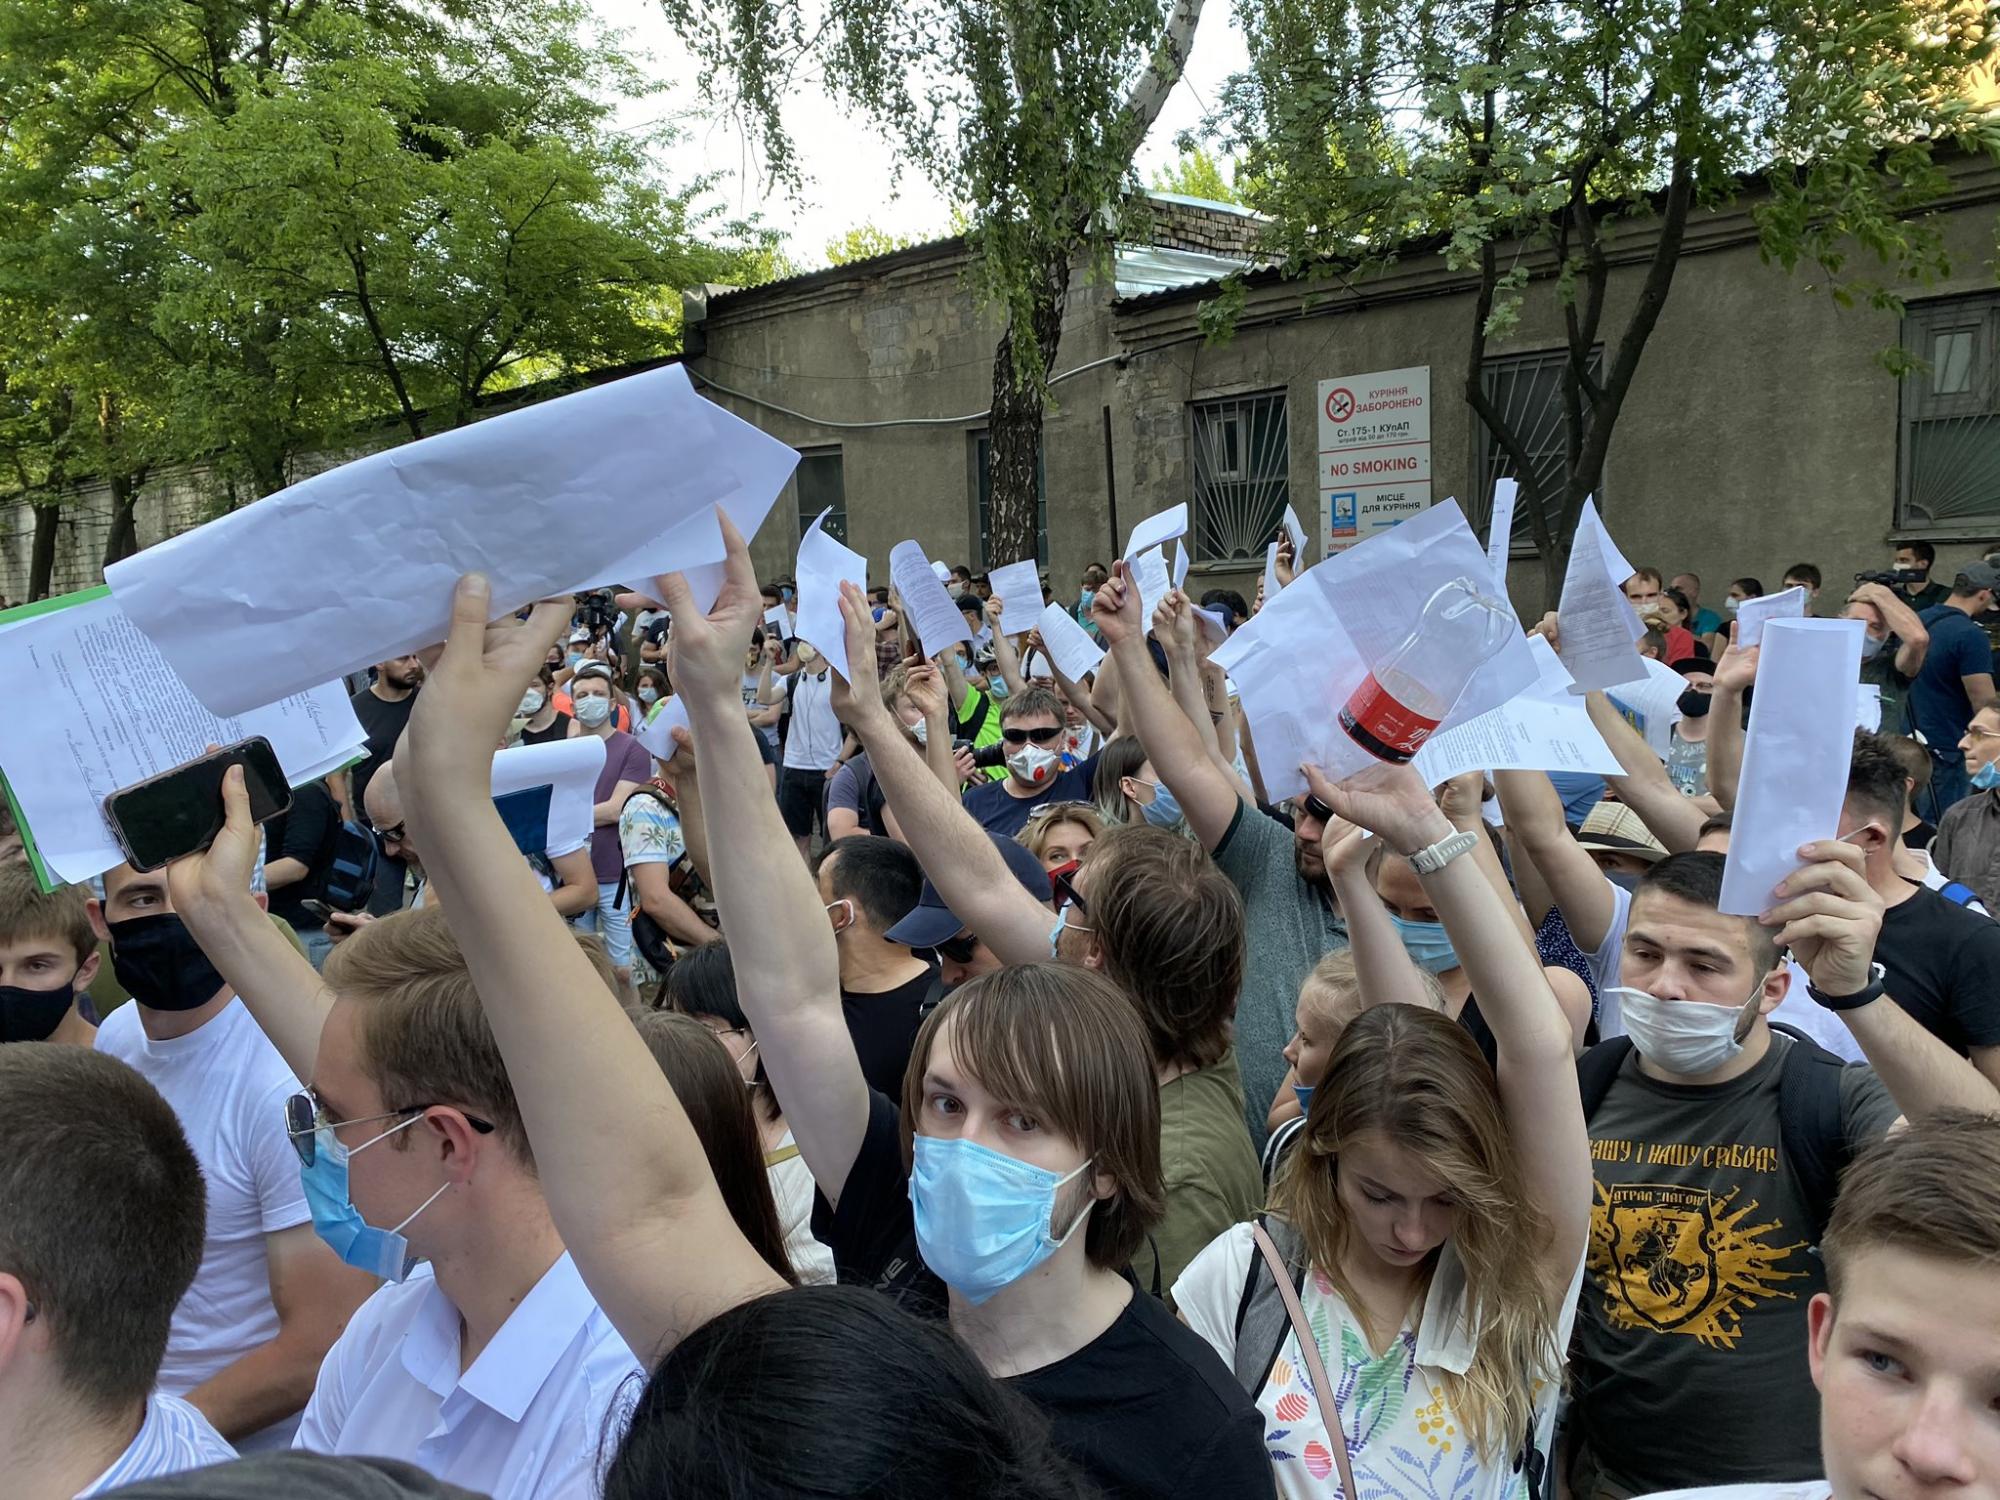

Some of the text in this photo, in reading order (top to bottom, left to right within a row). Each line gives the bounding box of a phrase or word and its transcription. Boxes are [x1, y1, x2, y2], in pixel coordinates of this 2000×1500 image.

[1369, 386, 1408, 399] КУРІННЯ
[1356, 397, 1422, 413] ЗАБОРОНЕНО
[1331, 457, 1417, 476] NO SMOKING
[1376, 493, 1405, 502] МІСЦЕ
[1361, 502, 1420, 514] ДЛЯ КУРІННЯ
[1647, 1144, 1701, 1167] НАШУ
